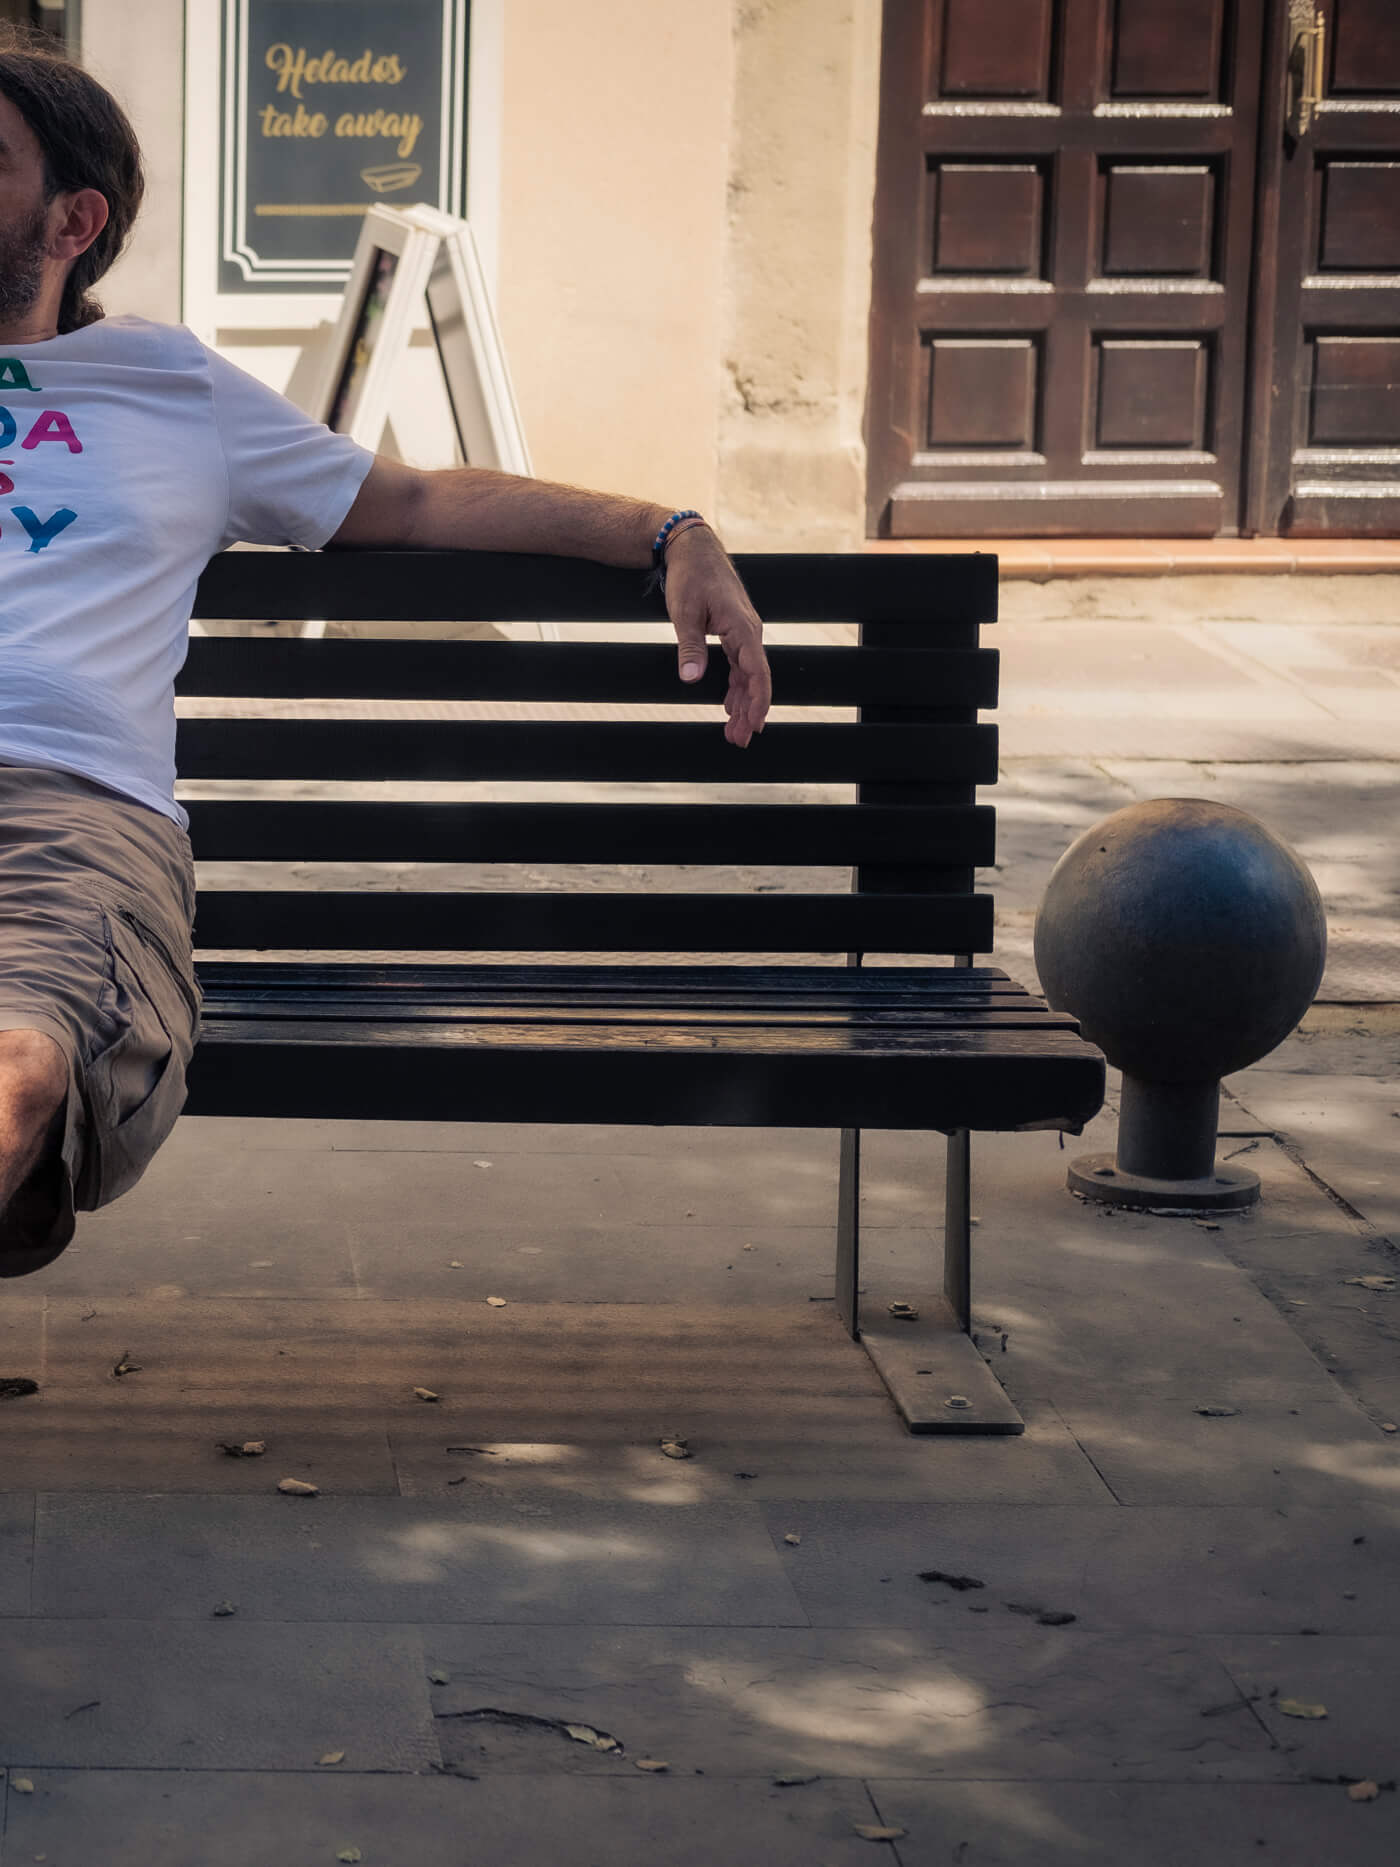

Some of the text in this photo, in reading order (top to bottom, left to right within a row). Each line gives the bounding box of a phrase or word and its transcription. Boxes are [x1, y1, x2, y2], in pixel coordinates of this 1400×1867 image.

[265, 43, 407, 98] Helados
[258, 104, 423, 158] take away
